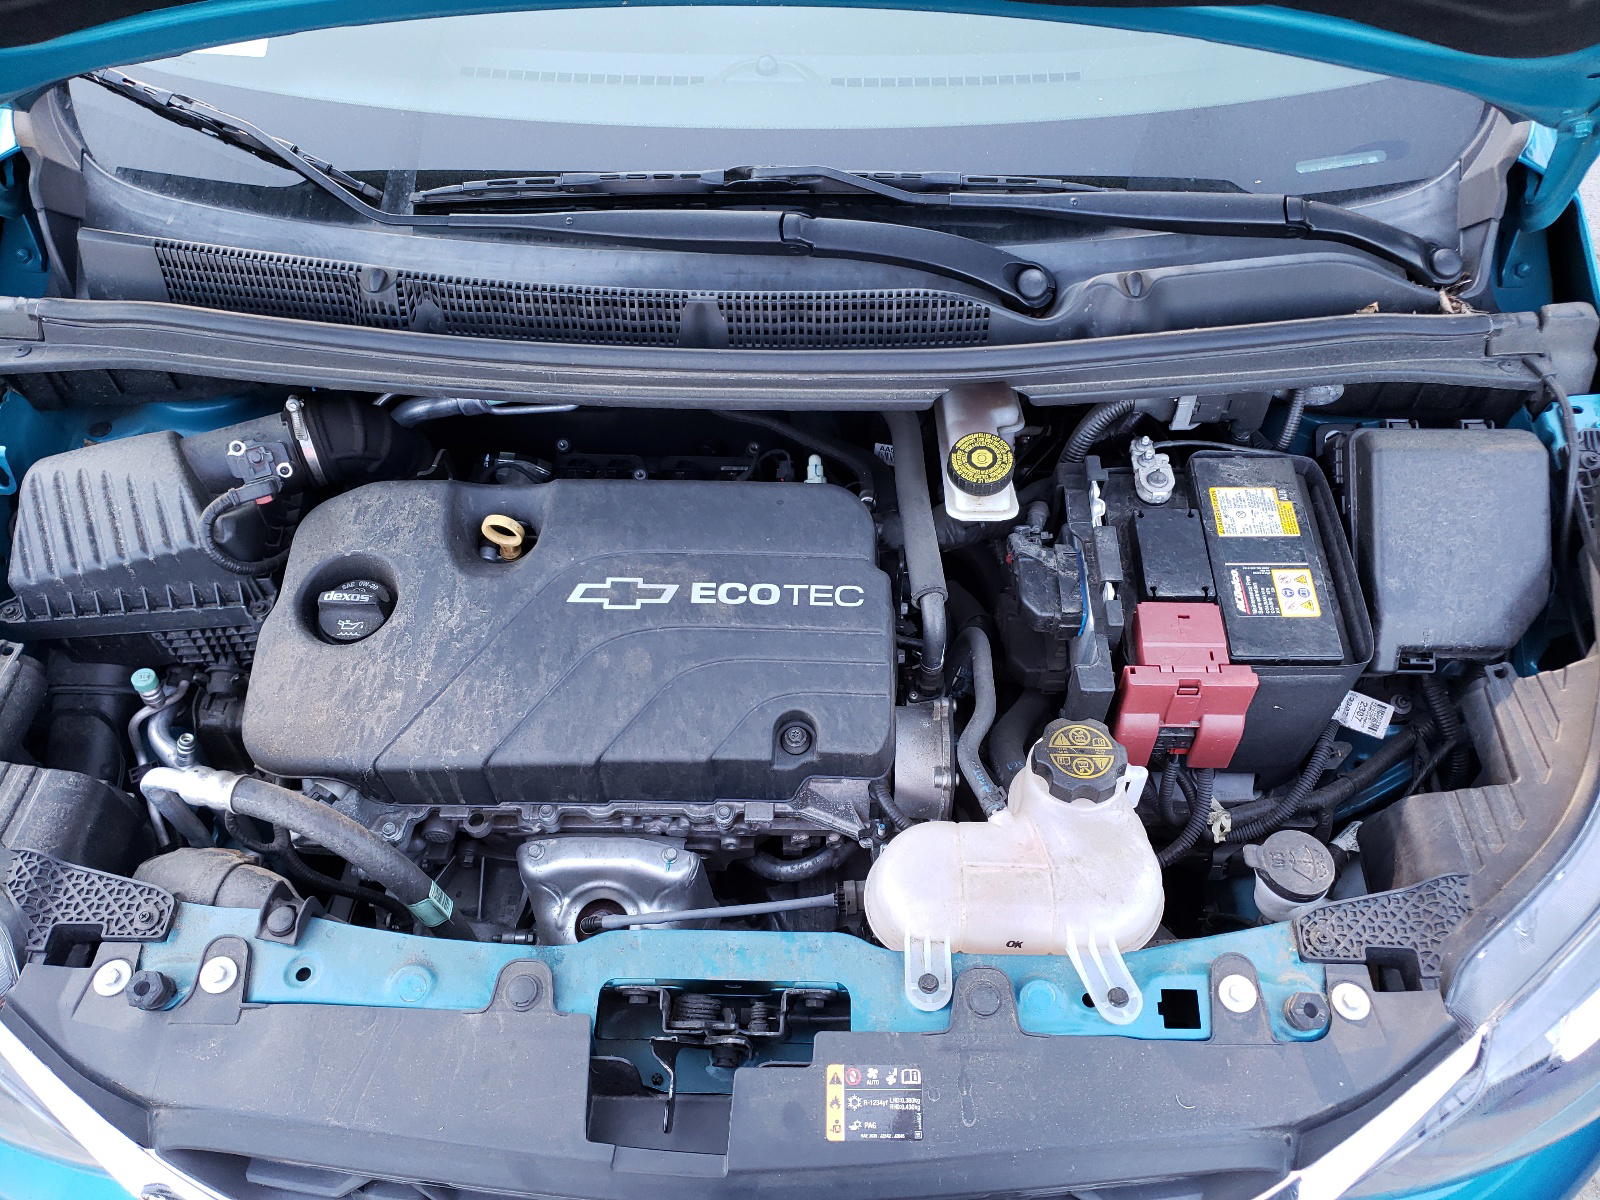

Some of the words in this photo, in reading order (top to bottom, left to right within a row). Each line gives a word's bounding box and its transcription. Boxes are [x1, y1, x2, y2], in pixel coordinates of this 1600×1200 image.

[341, 582, 355, 590] SAE
[690, 582, 865, 607] ECOTEC
[1354, 701, 1368, 722] 2307
[1006, 940, 1024, 949] OK
[863, 1099, 889, 1107] R-1234yf
[864, 1121, 877, 1129] PAG
